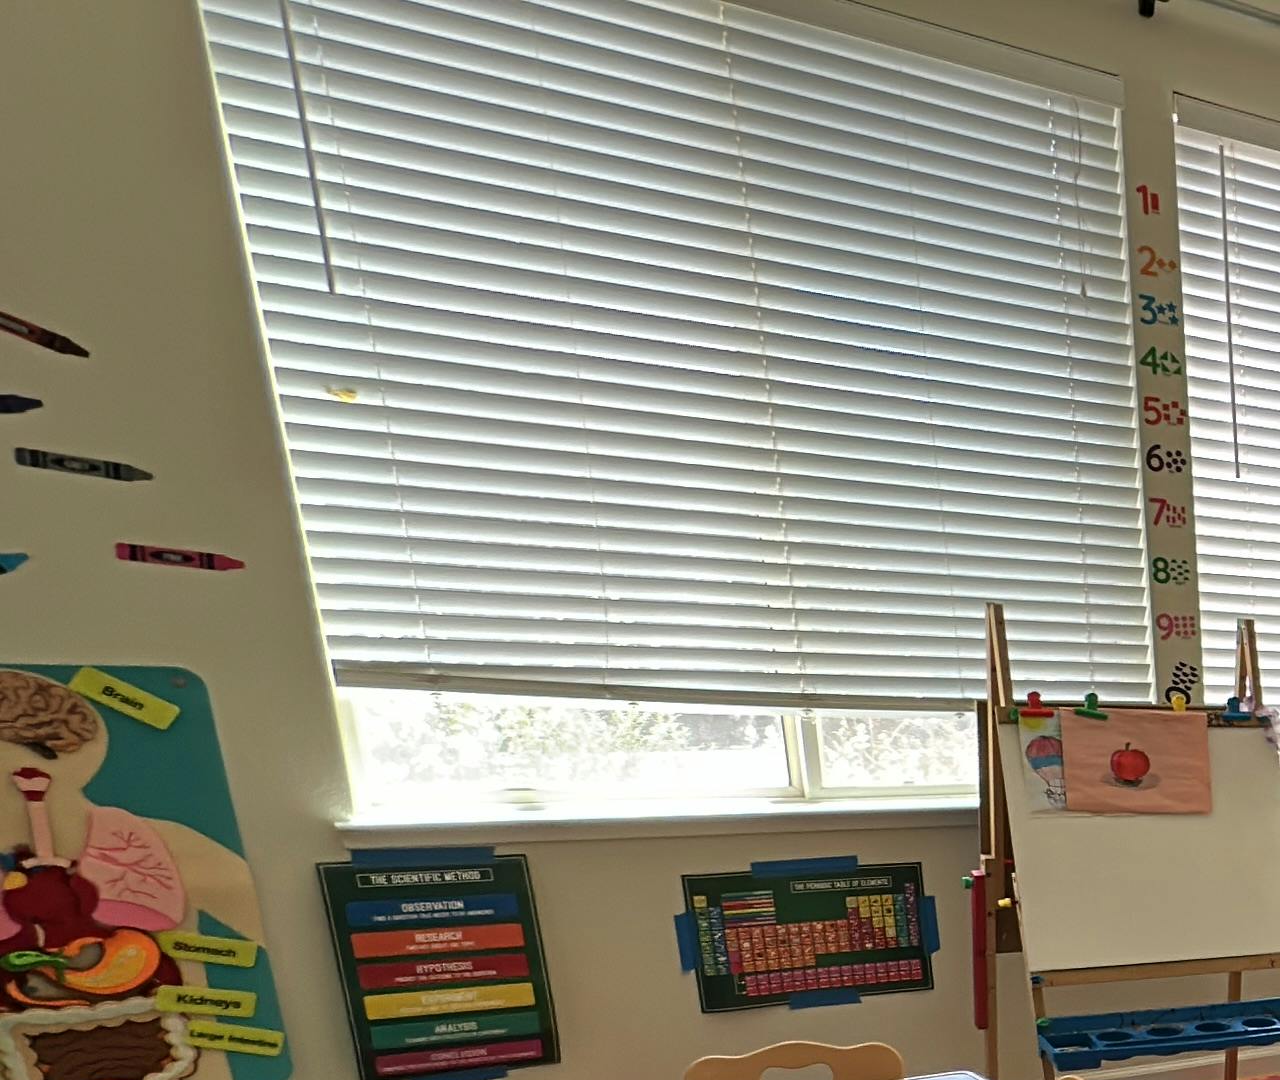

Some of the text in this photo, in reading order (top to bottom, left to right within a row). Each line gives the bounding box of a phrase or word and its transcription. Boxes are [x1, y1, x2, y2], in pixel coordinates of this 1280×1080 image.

[1136, 245, 1158, 277] 2
[1138, 294, 1158, 326] 3
[1139, 346, 1160, 375] 4
[1143, 396, 1163, 426] 5
[1145, 444, 1164, 473] 6
[1148, 497, 1168, 527] 7
[1152, 556, 1171, 584] 8
[1155, 613, 1174, 641] 9
[102, 685, 145, 711] Brain
[370, 870, 481, 884] THE SCIENTIFIC METHOD
[401, 899, 465, 913] OBSERVATION
[172, 940, 236, 957] Stomach
[416, 961, 474, 974] HYPOTHESIS
[176, 993, 242, 1010] Kidneys
[189, 1029, 224, 1041] Large
